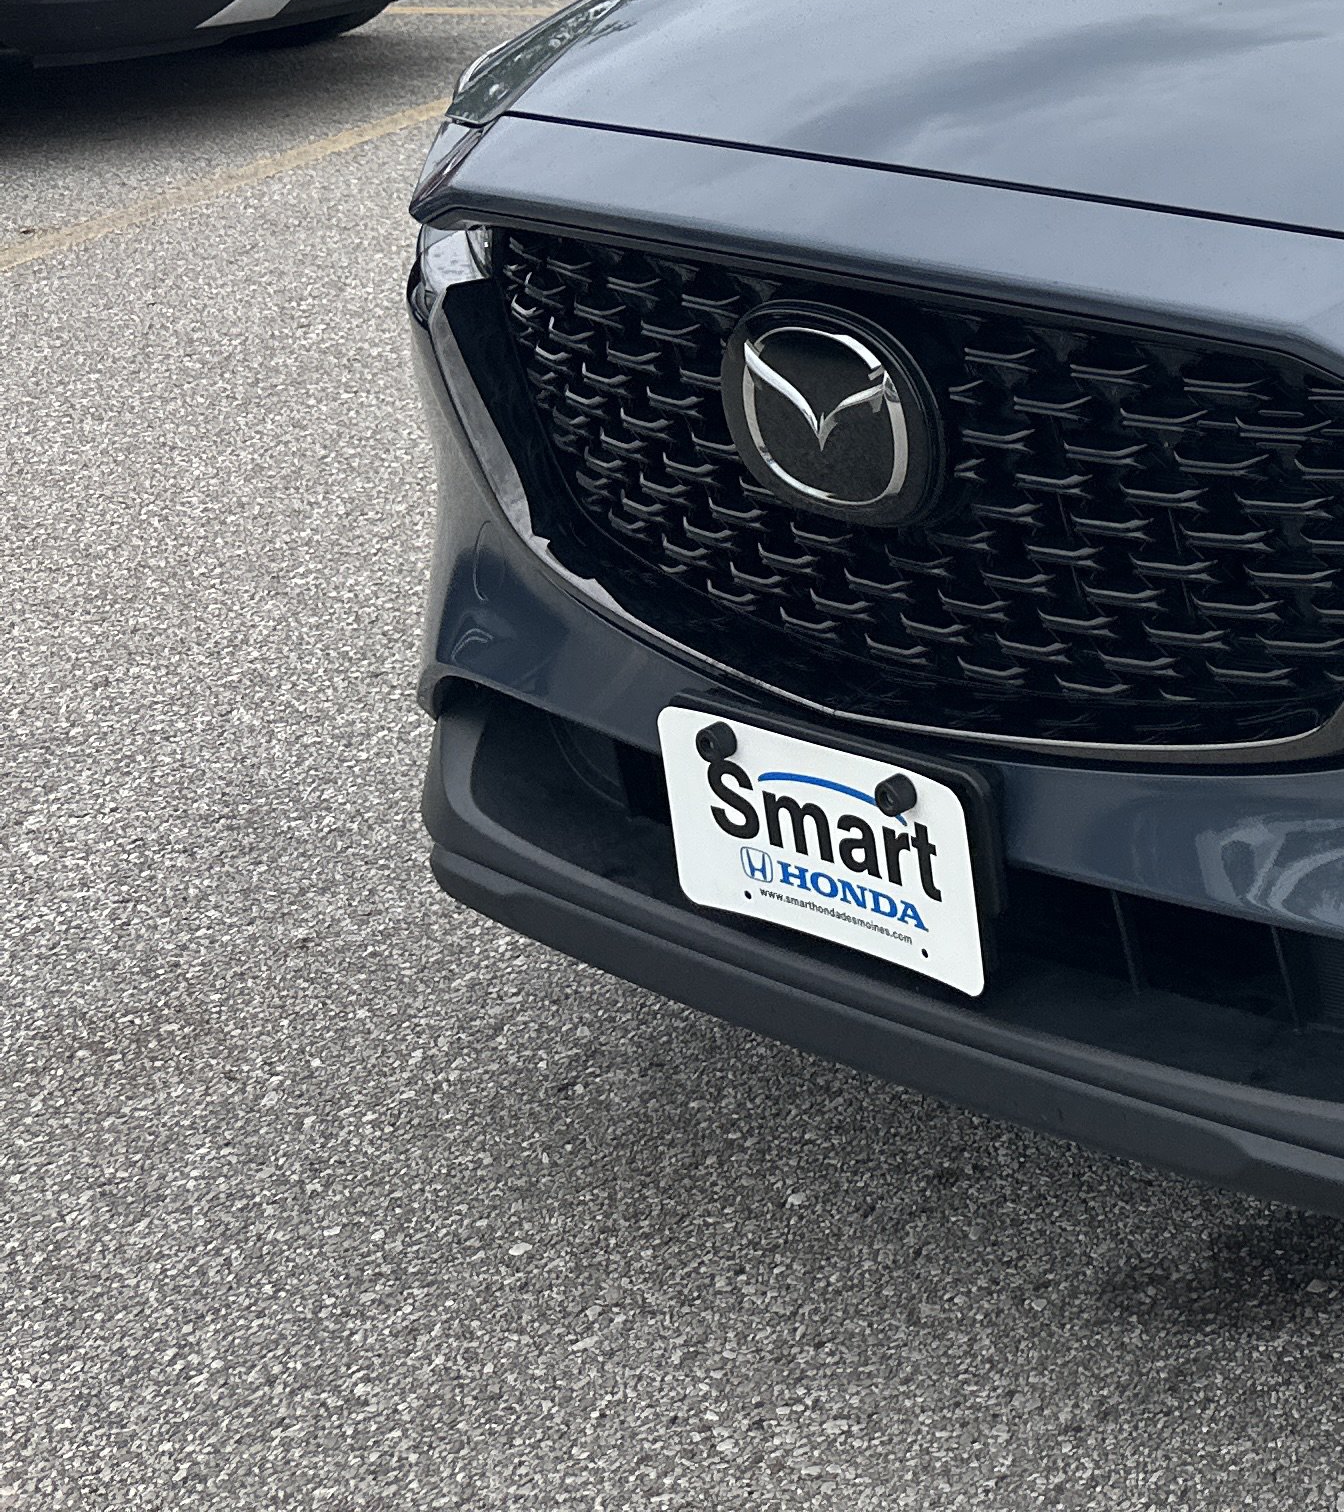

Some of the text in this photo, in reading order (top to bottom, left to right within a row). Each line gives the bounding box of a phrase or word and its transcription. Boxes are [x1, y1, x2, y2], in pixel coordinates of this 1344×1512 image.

[707, 759, 943, 902] Smart
[759, 887, 913, 946] www.smarthondadesmoines.com
[777, 860, 929, 932] HONDA
